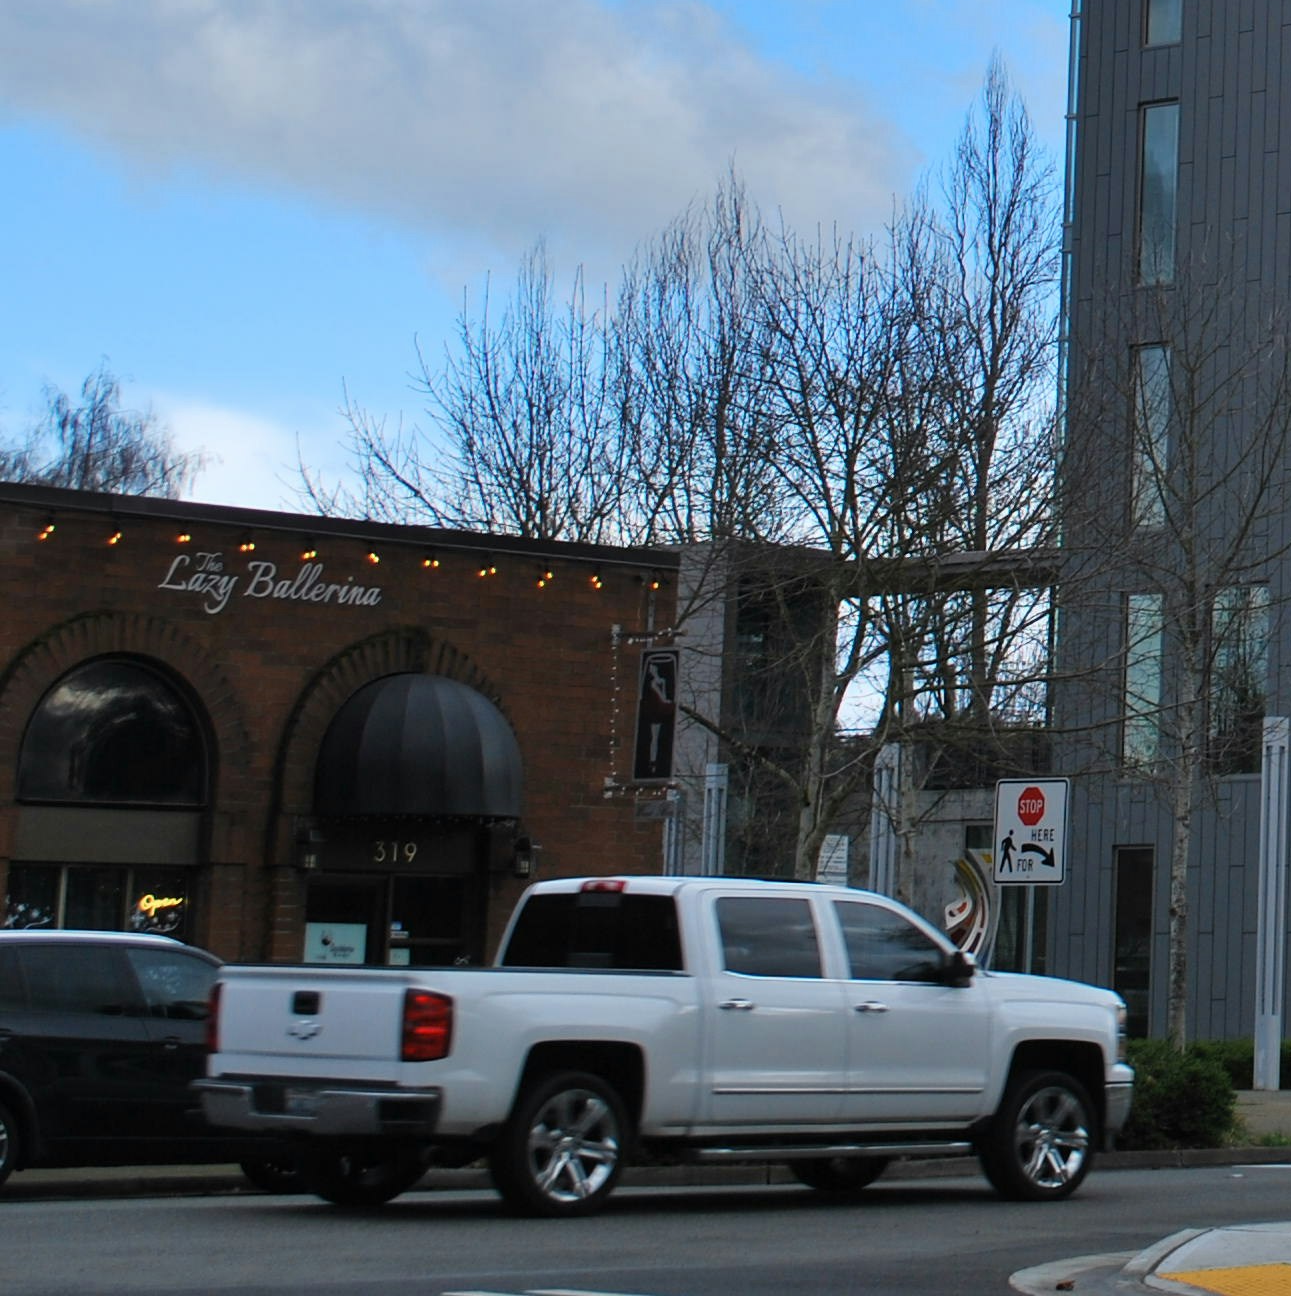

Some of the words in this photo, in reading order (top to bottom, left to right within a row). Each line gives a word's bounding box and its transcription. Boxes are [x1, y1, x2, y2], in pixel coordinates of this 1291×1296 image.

[196, 552, 223, 571] The
[158, 555, 239, 614] Lazy
[243, 561, 382, 606] Ballerina
[1019, 799, 1043, 814] STOP
[1031, 828, 1055, 842] HERE
[374, 841, 417, 863] 319
[1016, 858, 1034, 872] FOR
[139, 894, 183, 916] Open
